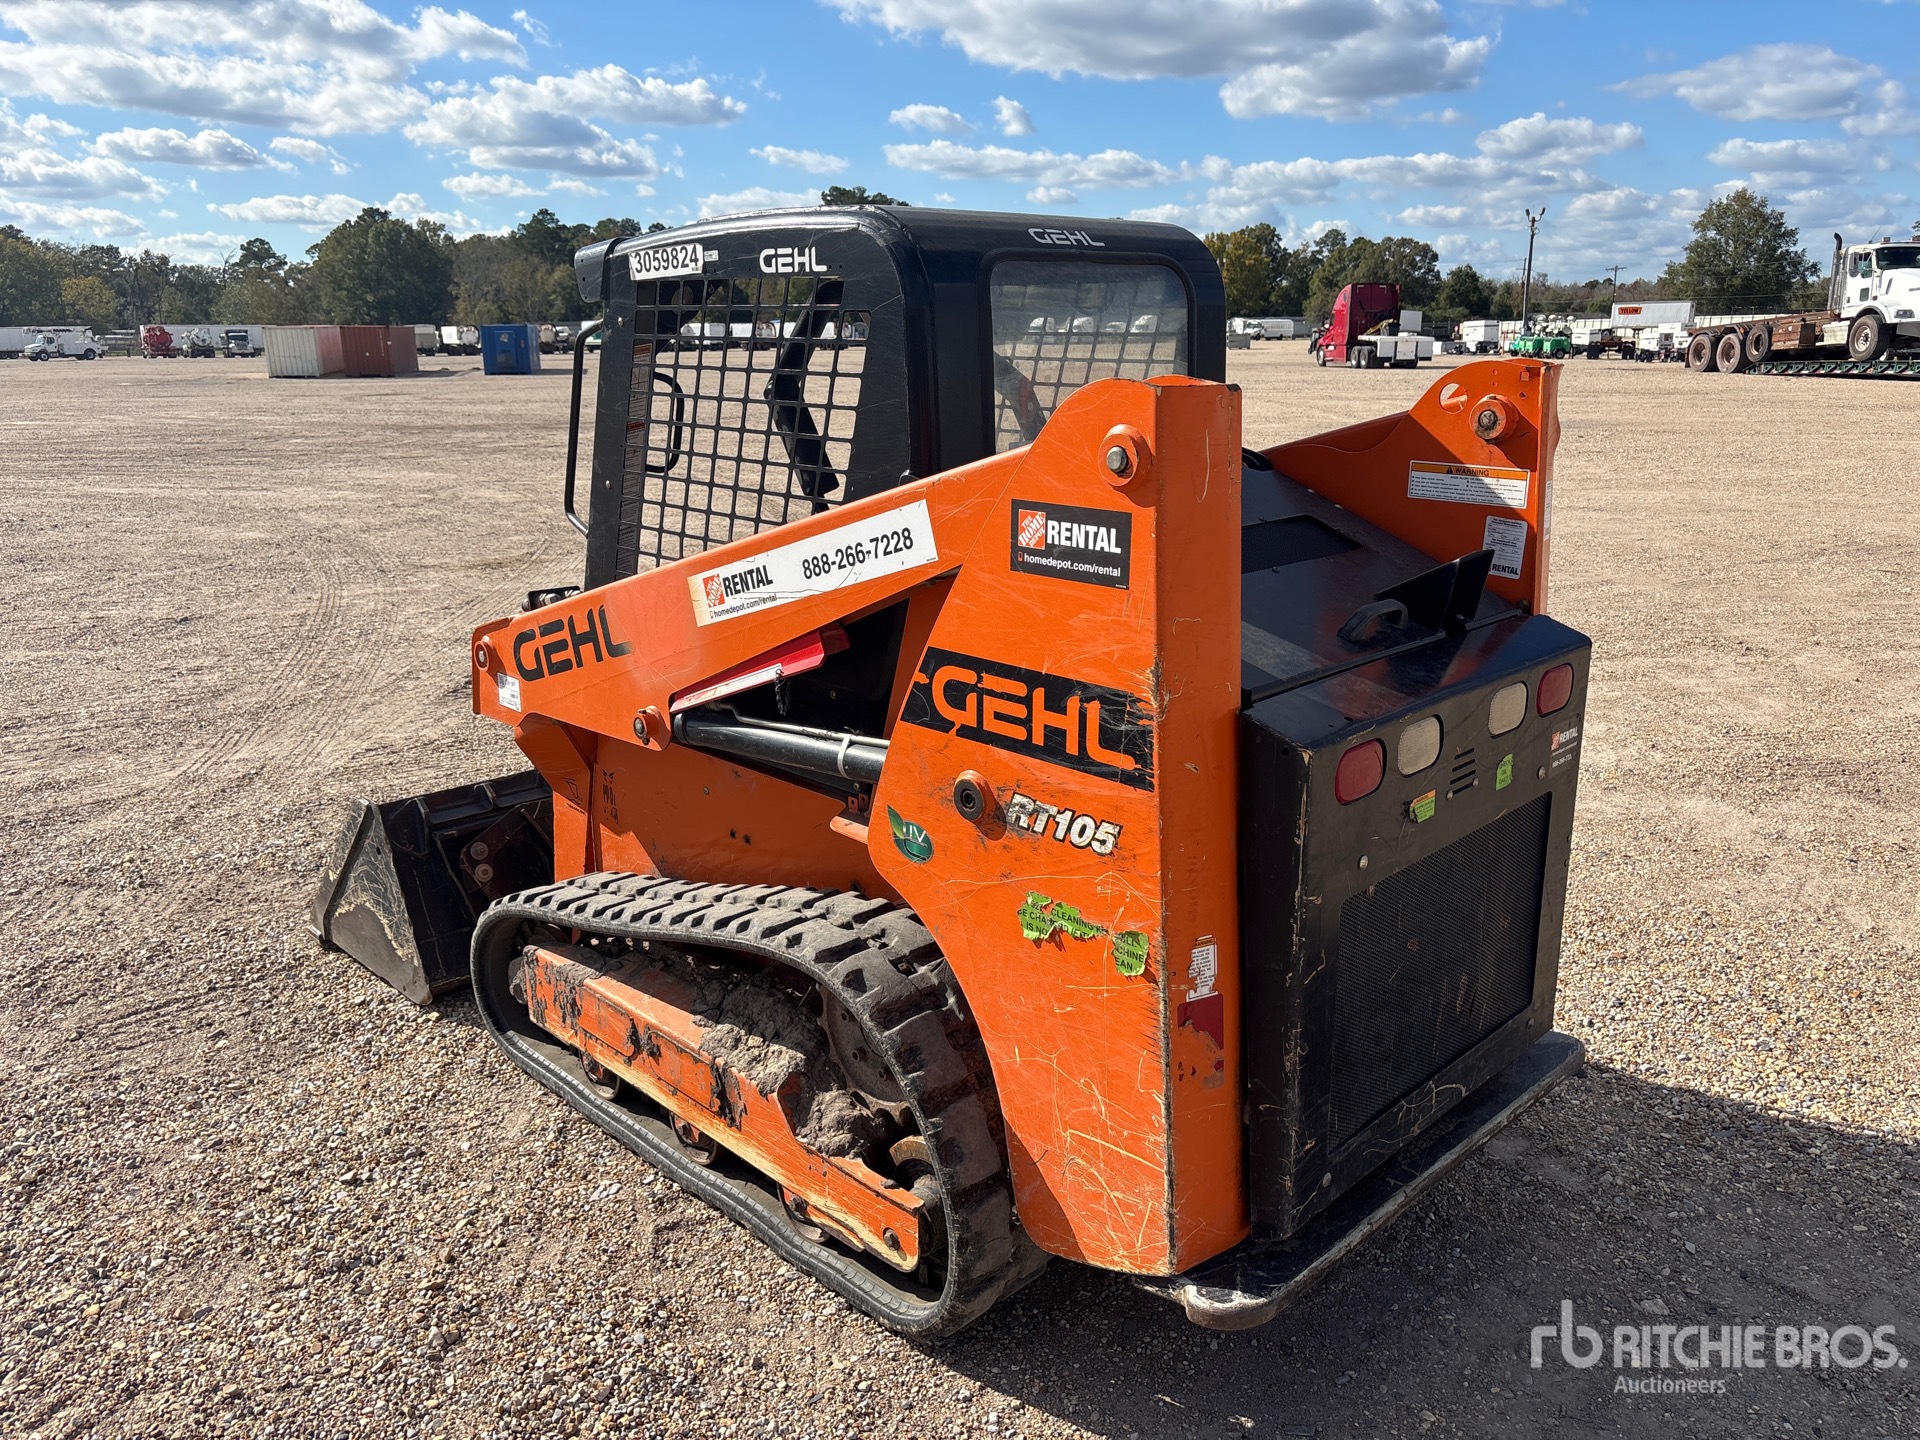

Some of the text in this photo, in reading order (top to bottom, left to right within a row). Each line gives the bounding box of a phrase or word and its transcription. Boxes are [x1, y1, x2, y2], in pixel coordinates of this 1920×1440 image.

[1028, 228, 1105, 246] GEHL
[634, 244, 699, 273] 3059824
[759, 246, 827, 273] GEHL
[1455, 468, 1489, 476] WARNING
[1047, 520, 1121, 554] RENTAL
[802, 527, 914, 580] 888-266-7228
[1024, 553, 1121, 577] homedepot.com/rental
[722, 565, 773, 597] RENTAL
[1492, 563, 1519, 575] RENTAL
[714, 593, 778, 617] homedepot.com/rental
[513, 604, 635, 682] GEHL
[931, 665, 1136, 771] GEHL
[1006, 791, 1122, 856] RT105
[1026, 921, 1034, 931] IS
[1051, 908, 1095, 931] CLEANING
